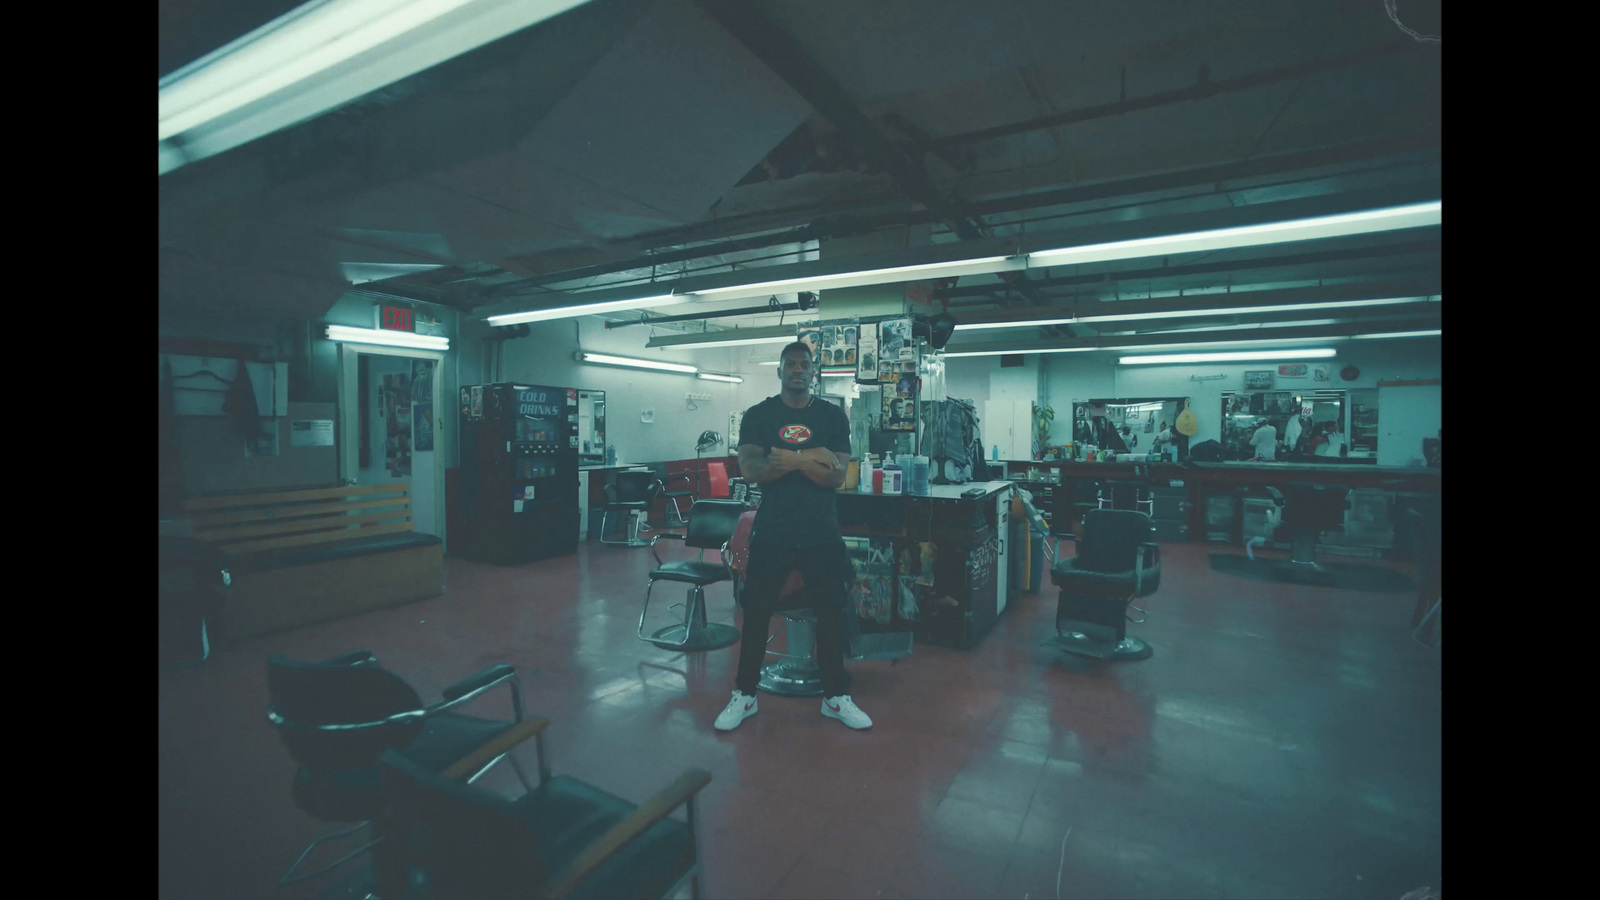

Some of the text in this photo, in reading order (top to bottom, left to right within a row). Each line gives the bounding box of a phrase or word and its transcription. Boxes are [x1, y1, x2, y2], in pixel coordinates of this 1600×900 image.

[383, 306, 413, 331] EXIT
[520, 391, 547, 403] COLD
[520, 404, 559, 415] DRINKS
